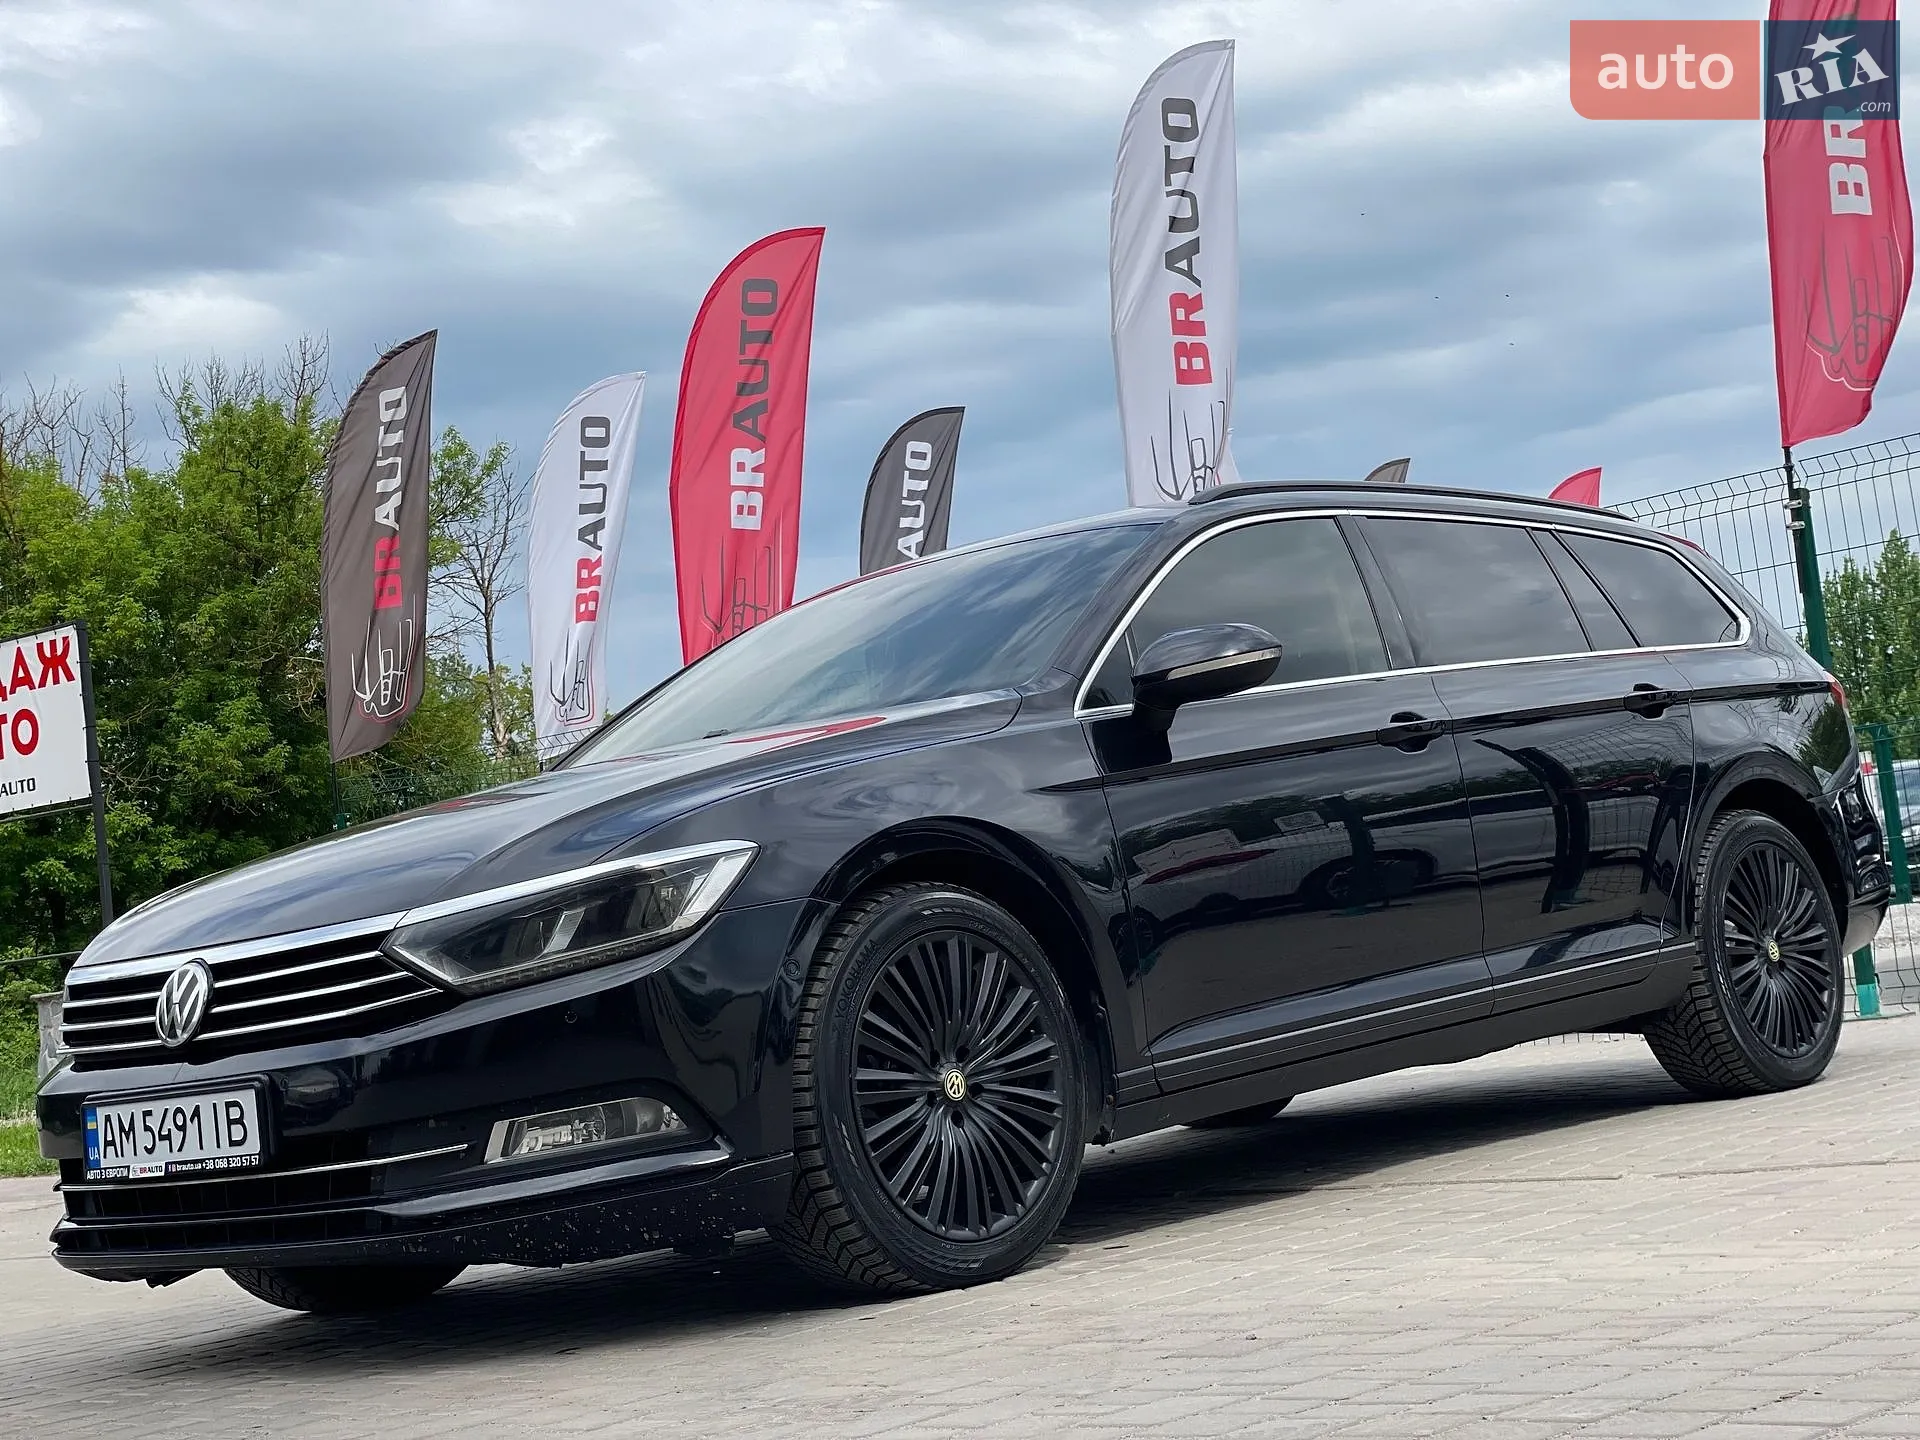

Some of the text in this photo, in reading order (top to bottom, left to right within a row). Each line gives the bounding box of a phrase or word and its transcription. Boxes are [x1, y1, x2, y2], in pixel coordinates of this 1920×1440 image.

[1161, 97, 1213, 386] BRAUTO
[730, 278, 779, 531] BRAUTO
[375, 385, 408, 610] BRAUTO
[575, 416, 611, 624] BRAUTO
[897, 441, 932, 560] AUTO
[834, 939, 879, 1019] YOKOHAMA
[88, 1147, 100, 1160] UA
[103, 1099, 248, 1159] AM 5491 IB
[139, 1165, 163, 1175] BRAUTO
[215, 1158, 228, 1169] 068
[229, 1157, 241, 1167] 320
